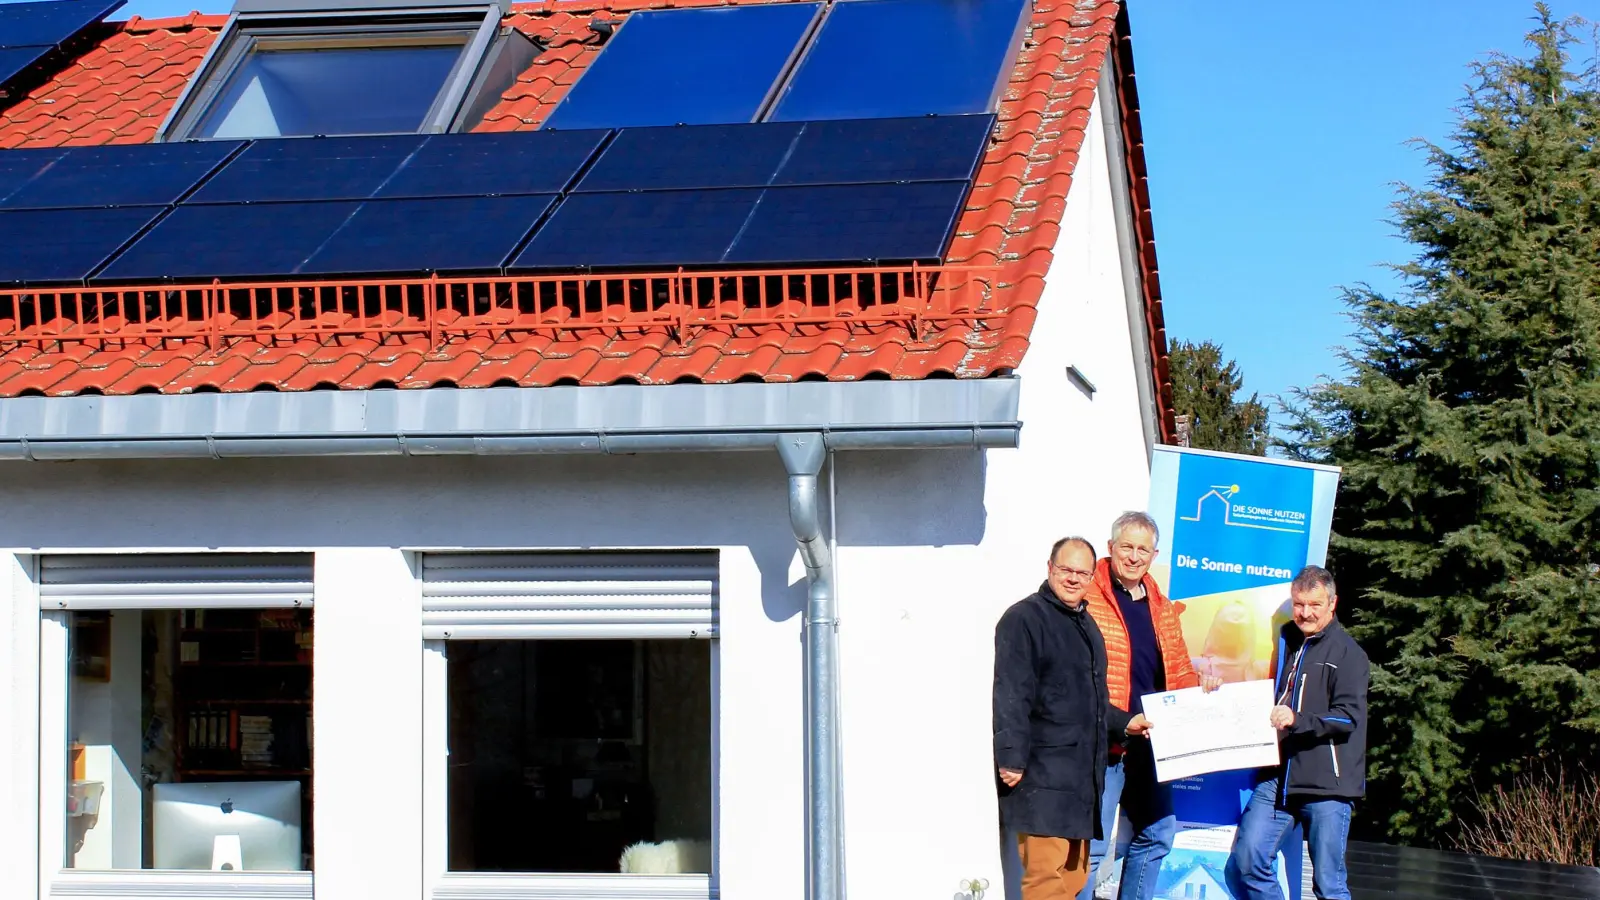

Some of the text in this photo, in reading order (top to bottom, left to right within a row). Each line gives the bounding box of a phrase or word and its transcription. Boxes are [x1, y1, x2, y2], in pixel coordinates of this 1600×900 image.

[1232, 504, 1305, 520] DIE SONNE NUTZEN
[1176, 554, 1292, 579] Die Sonne nutzen
